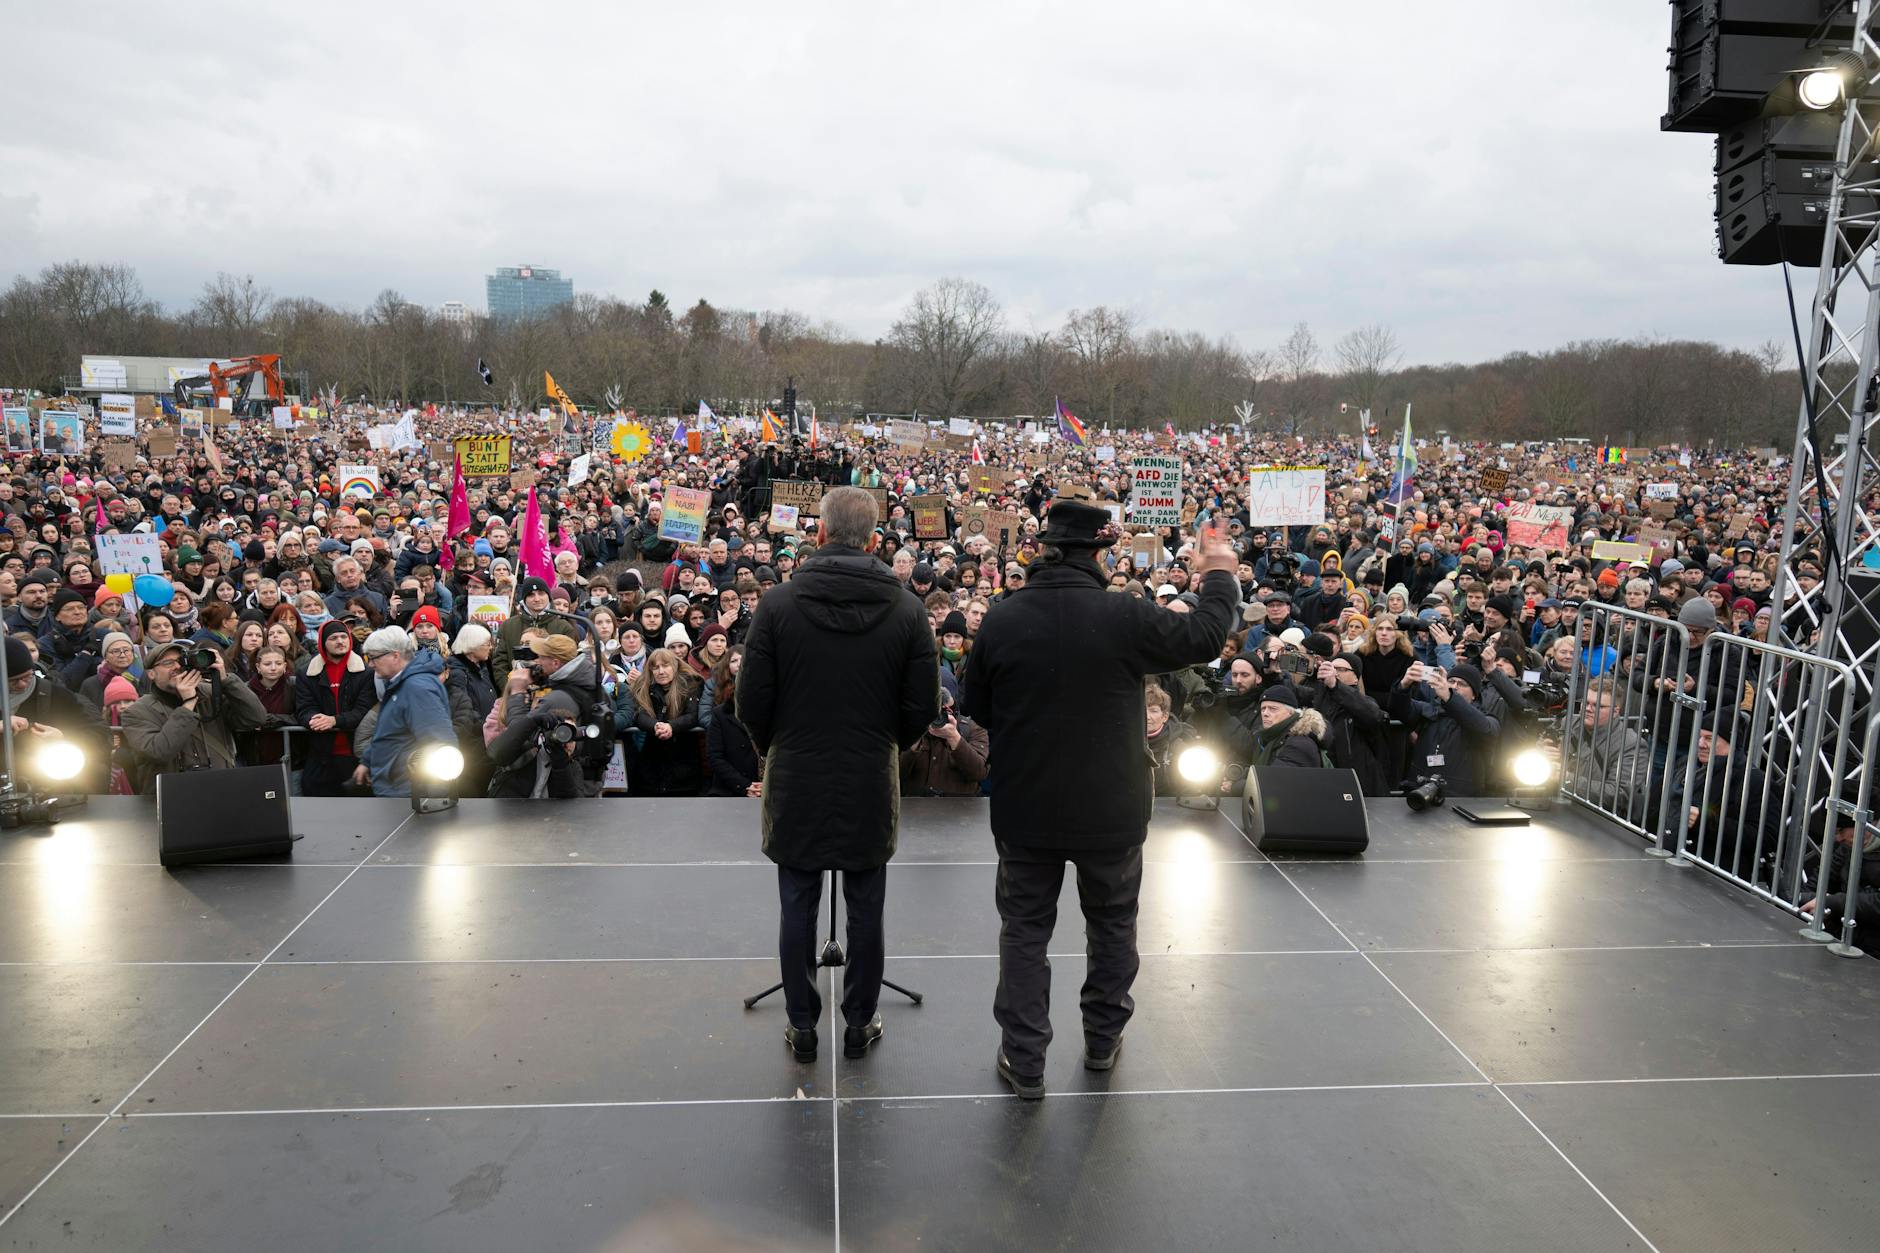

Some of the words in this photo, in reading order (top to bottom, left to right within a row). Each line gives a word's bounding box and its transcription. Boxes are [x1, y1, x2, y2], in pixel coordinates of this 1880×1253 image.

[469, 441, 500, 452] BUNT
[466, 453, 499, 463] STATT
[1133, 458, 1165, 467] WENN
[1165, 461, 1180, 469] DIE
[345, 466, 355, 475] Ich
[1136, 470, 1160, 480] AFD
[1164, 473, 1179, 481] DIE
[1485, 471, 1506, 480] NAZIS
[1483, 479, 1503, 488] RAUS!
[787, 483, 816, 497] HERZ
[675, 500, 696, 511] NAZI
[1139, 498, 1174, 507] DUMM
[664, 519, 699, 532] HAPPY!
[1150, 517, 1181, 525] FRAGE
[1381, 526, 1394, 539] AFD
